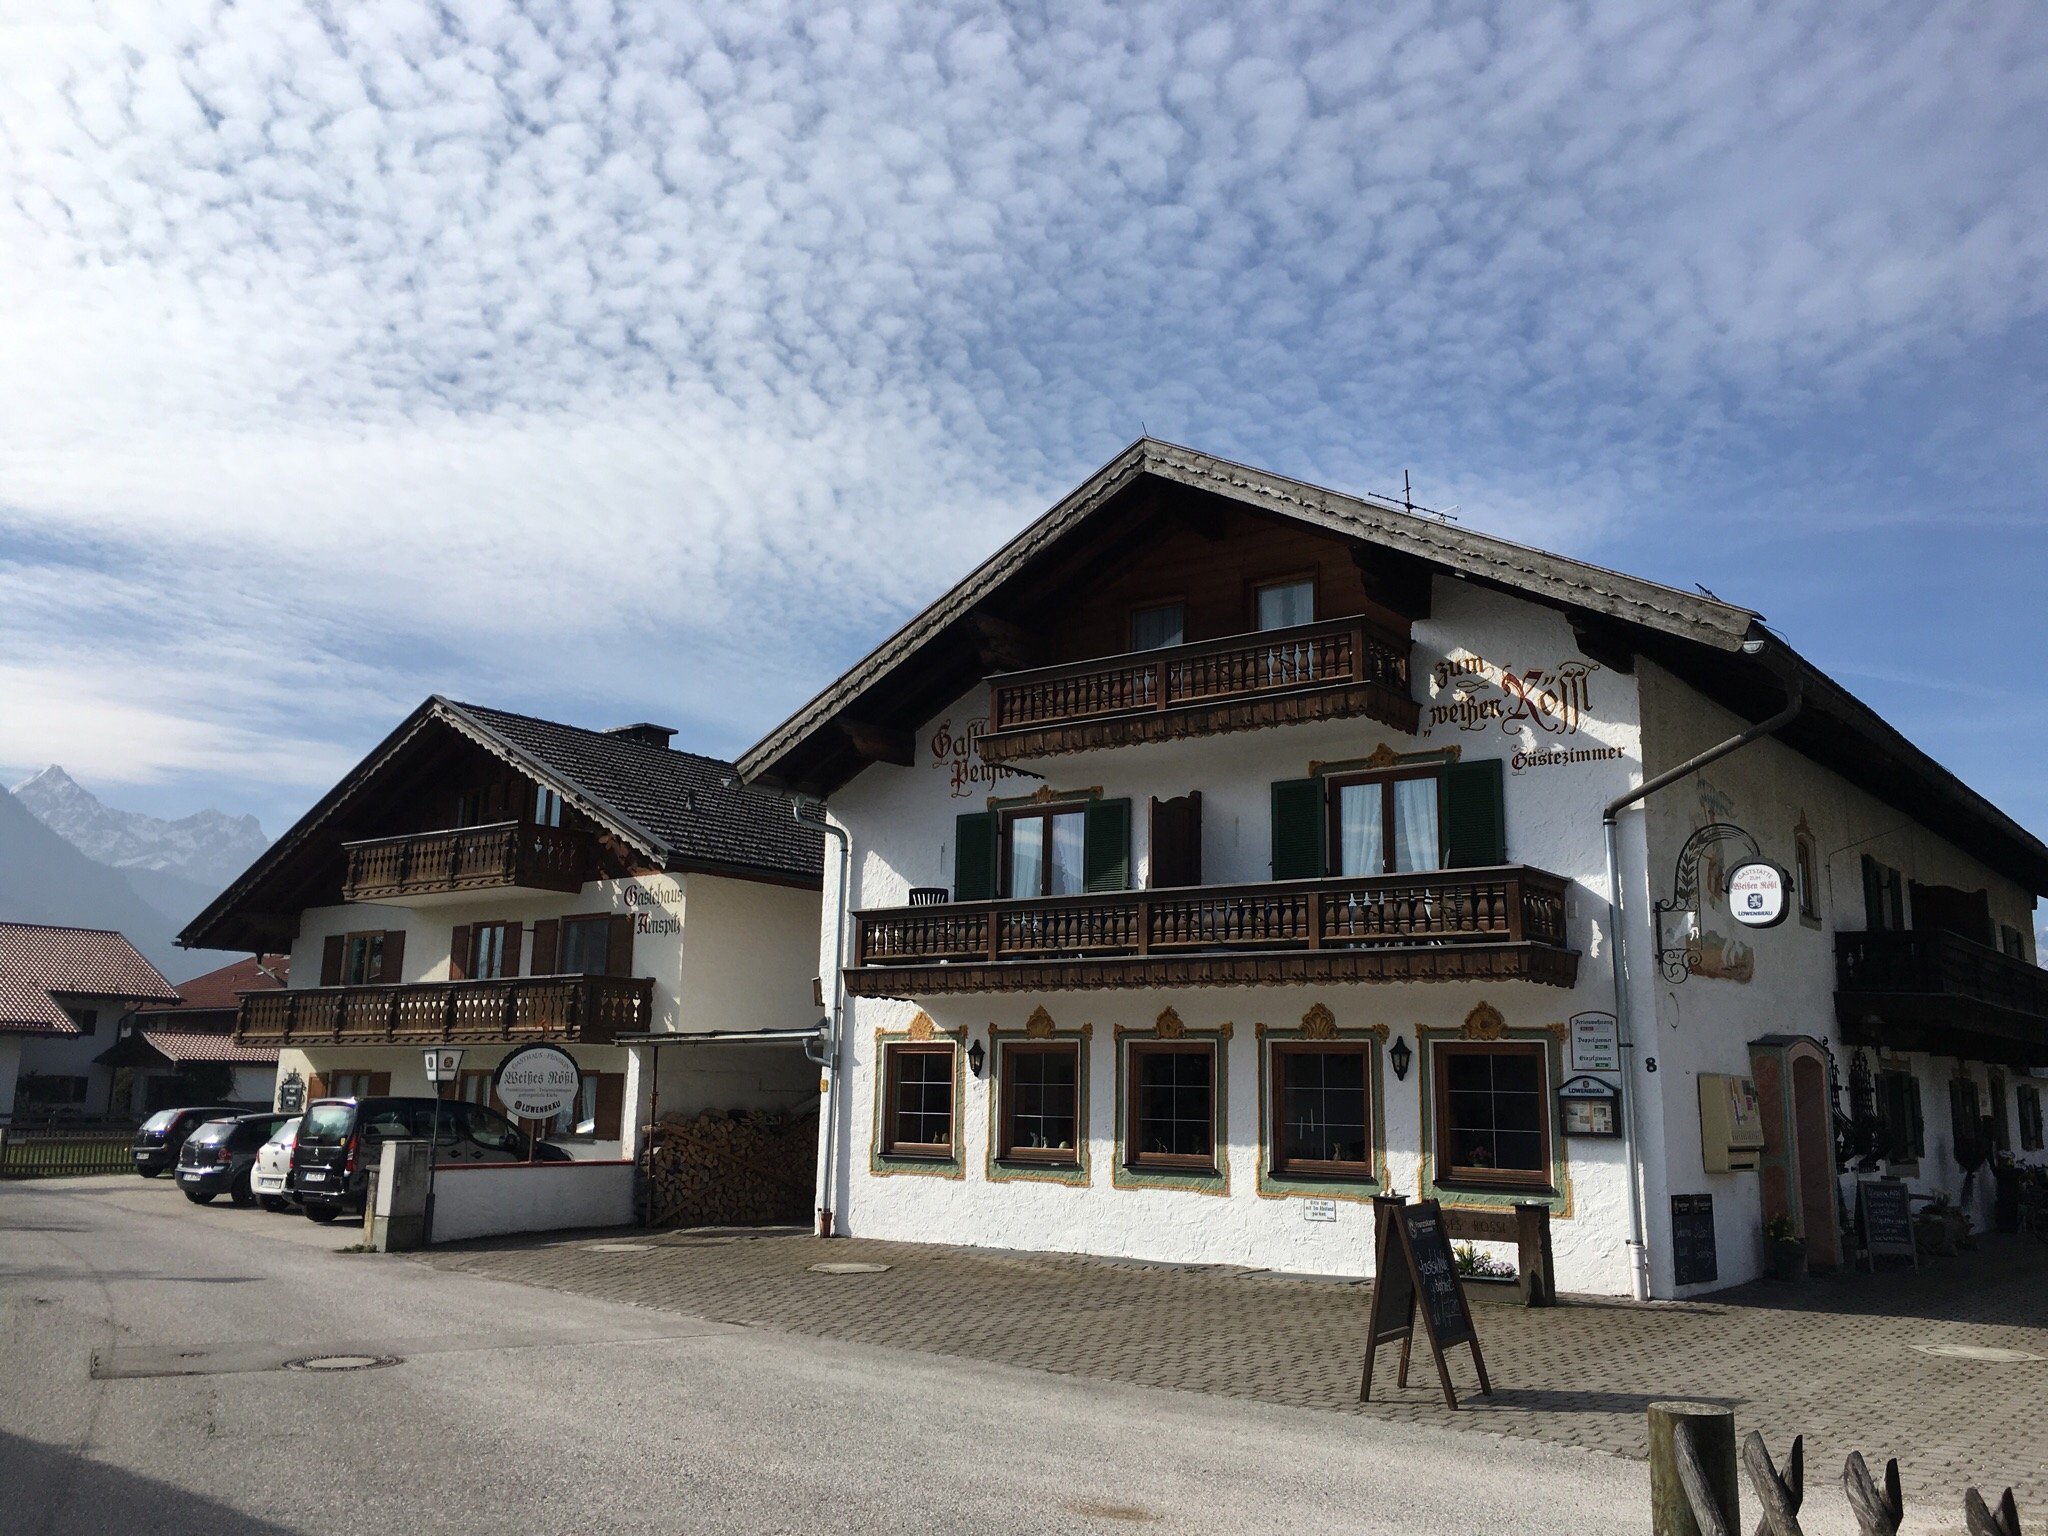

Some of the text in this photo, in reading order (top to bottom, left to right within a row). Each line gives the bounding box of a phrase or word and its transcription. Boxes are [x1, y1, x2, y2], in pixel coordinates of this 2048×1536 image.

[1434, 656, 1490, 689] zum
[1511, 746, 1625, 773] Gästezimmer
[623, 884, 683, 908] Gästehaus
[1645, 1056, 1658, 1073] 8
[503, 1070, 575, 1086] Weißes Rößl
[521, 1100, 561, 1114] LÖWENBRÄU
